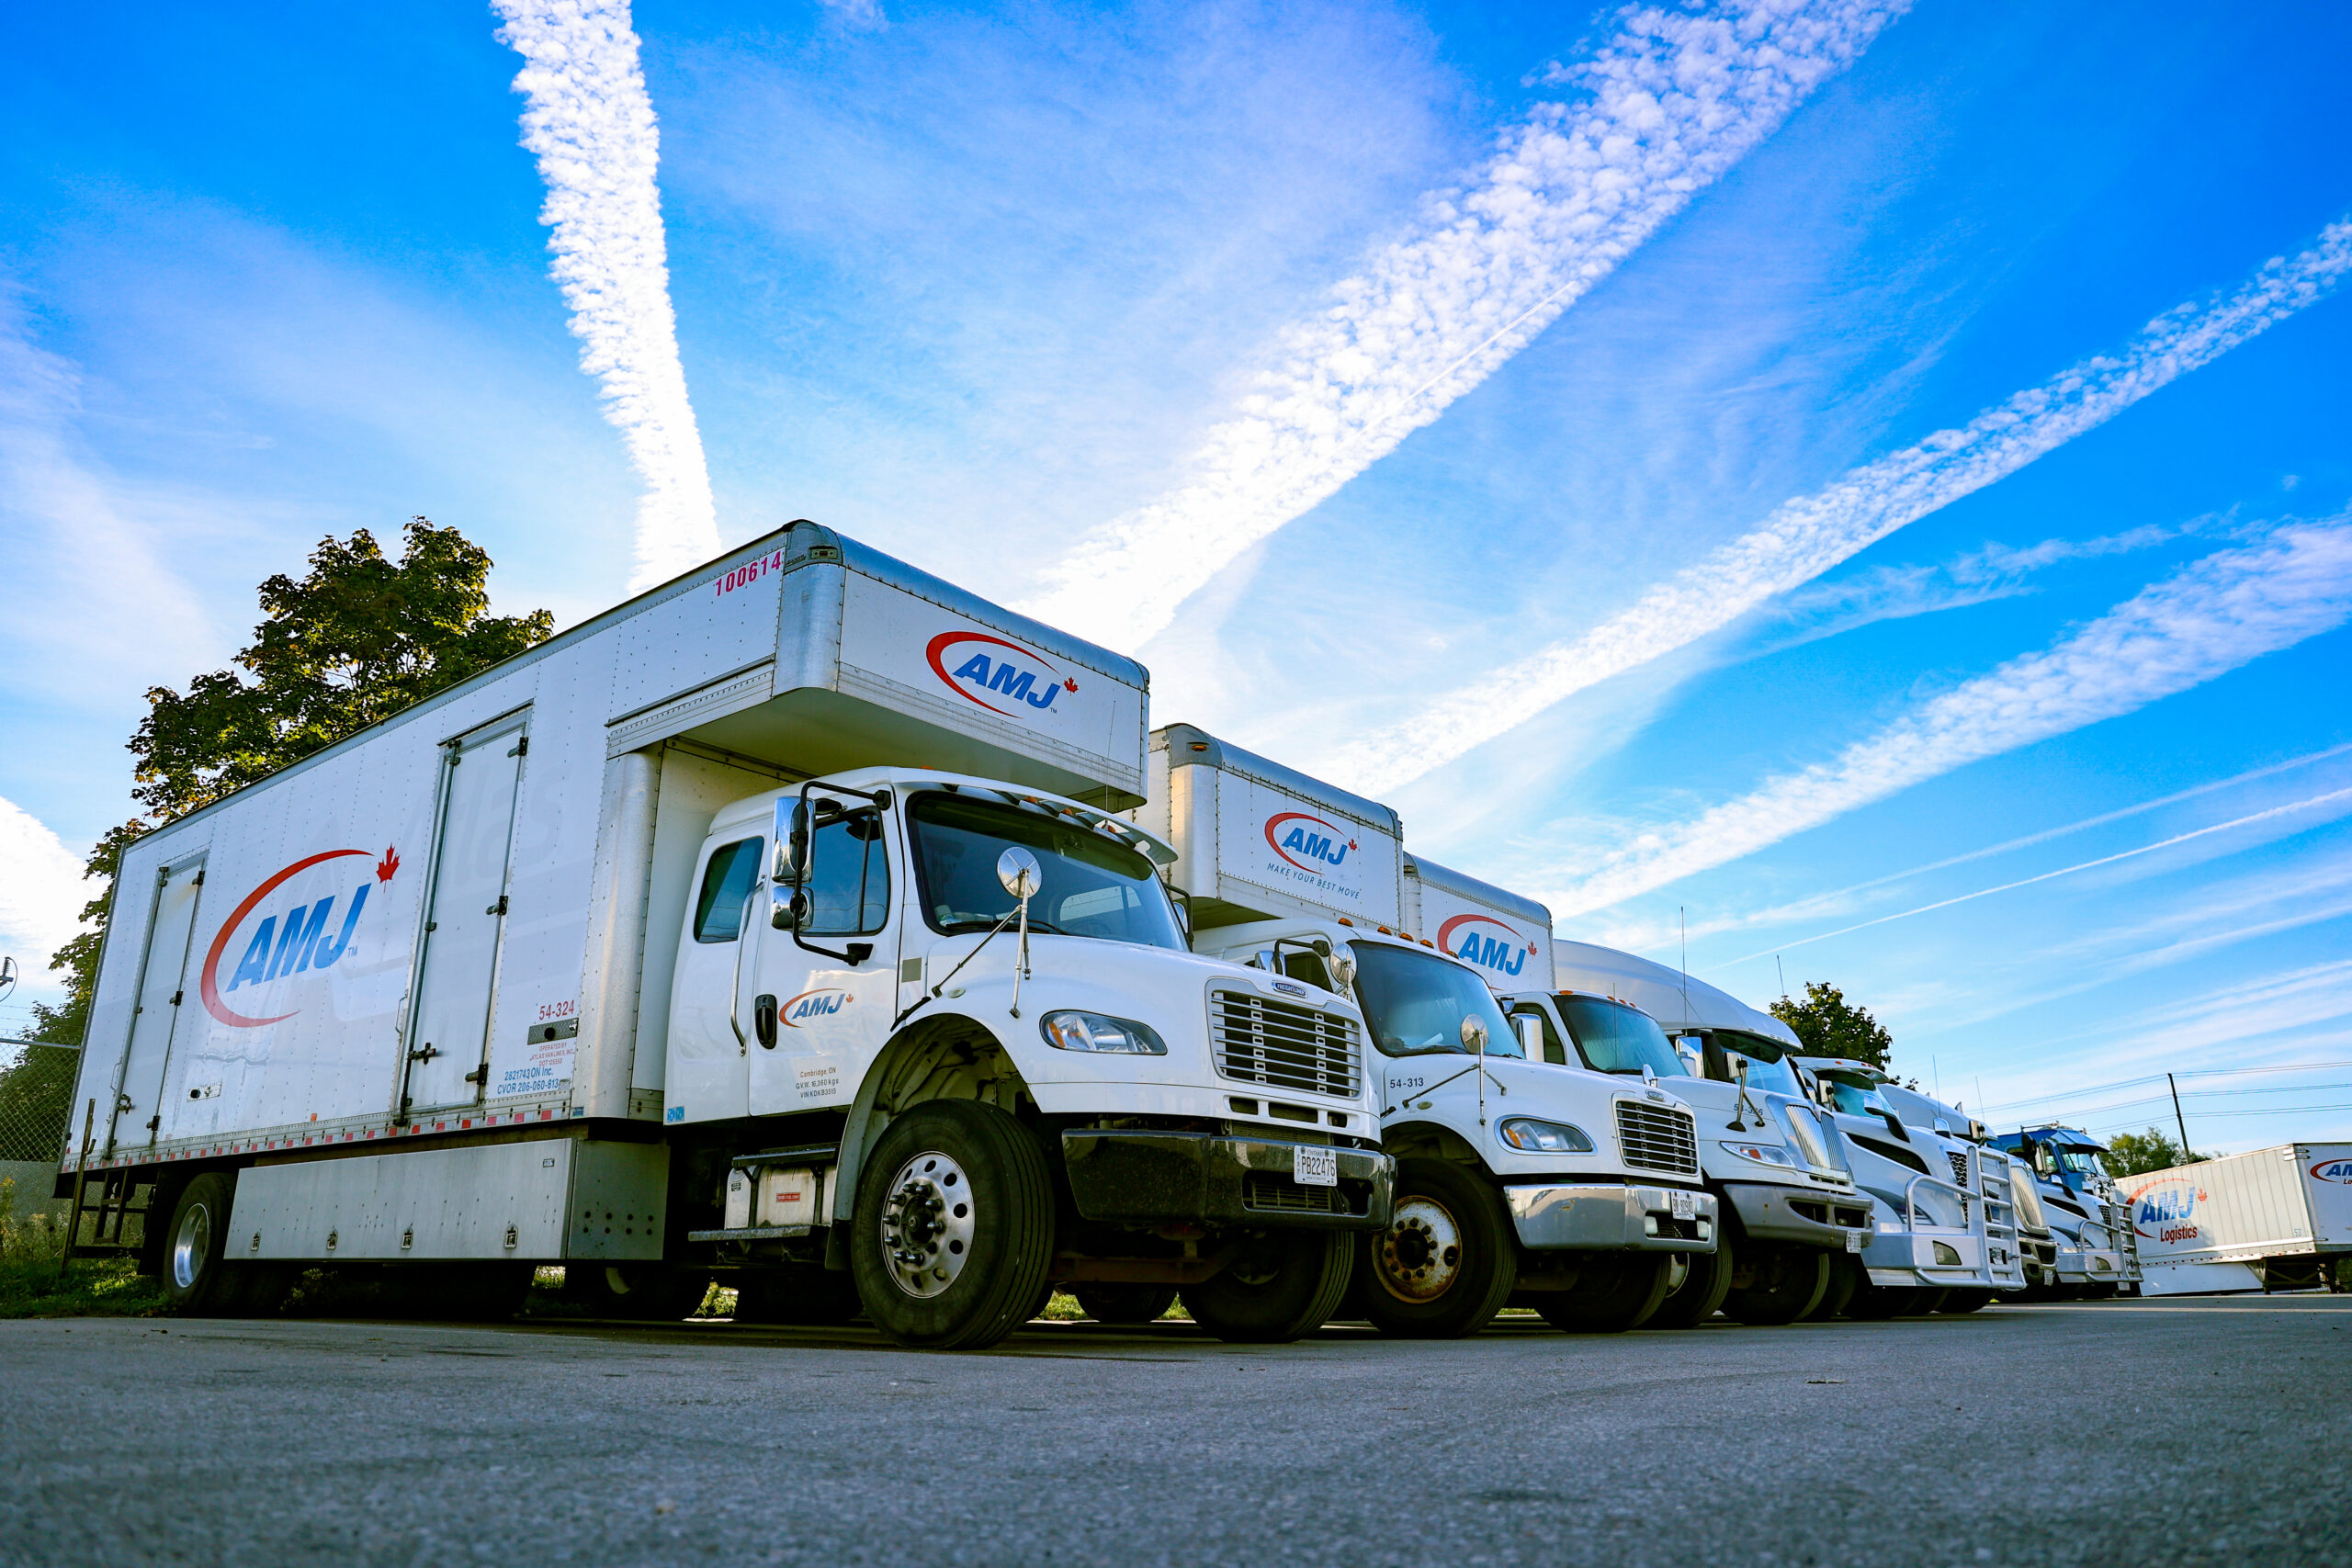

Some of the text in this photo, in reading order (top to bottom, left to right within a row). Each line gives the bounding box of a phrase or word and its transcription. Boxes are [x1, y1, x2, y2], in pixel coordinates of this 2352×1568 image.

[715, 551, 782, 597] 100614
[952, 653, 1061, 709] AMJ
[1282, 827, 1348, 865] AMJ
[1267, 863, 1360, 899] MAKE YOUR BEST MOVE
[225, 883, 372, 993] AMJ TM
[1457, 931, 1527, 976] AMJ
[538, 999, 575, 1021] 54-324
[791, 993, 845, 1020] AMJ
[504, 1066, 554, 1081] 2821743 ON Inc.
[828, 1066, 836, 1075] ON
[1389, 1077, 1424, 1089] 54-313
[497, 1077, 560, 1095] CVOR 206-060-813
[1301, 1156, 1336, 1177] PB22476
[2139, 1186, 2196, 1224] AMJ
[2160, 1224, 2198, 1245] Logistics
